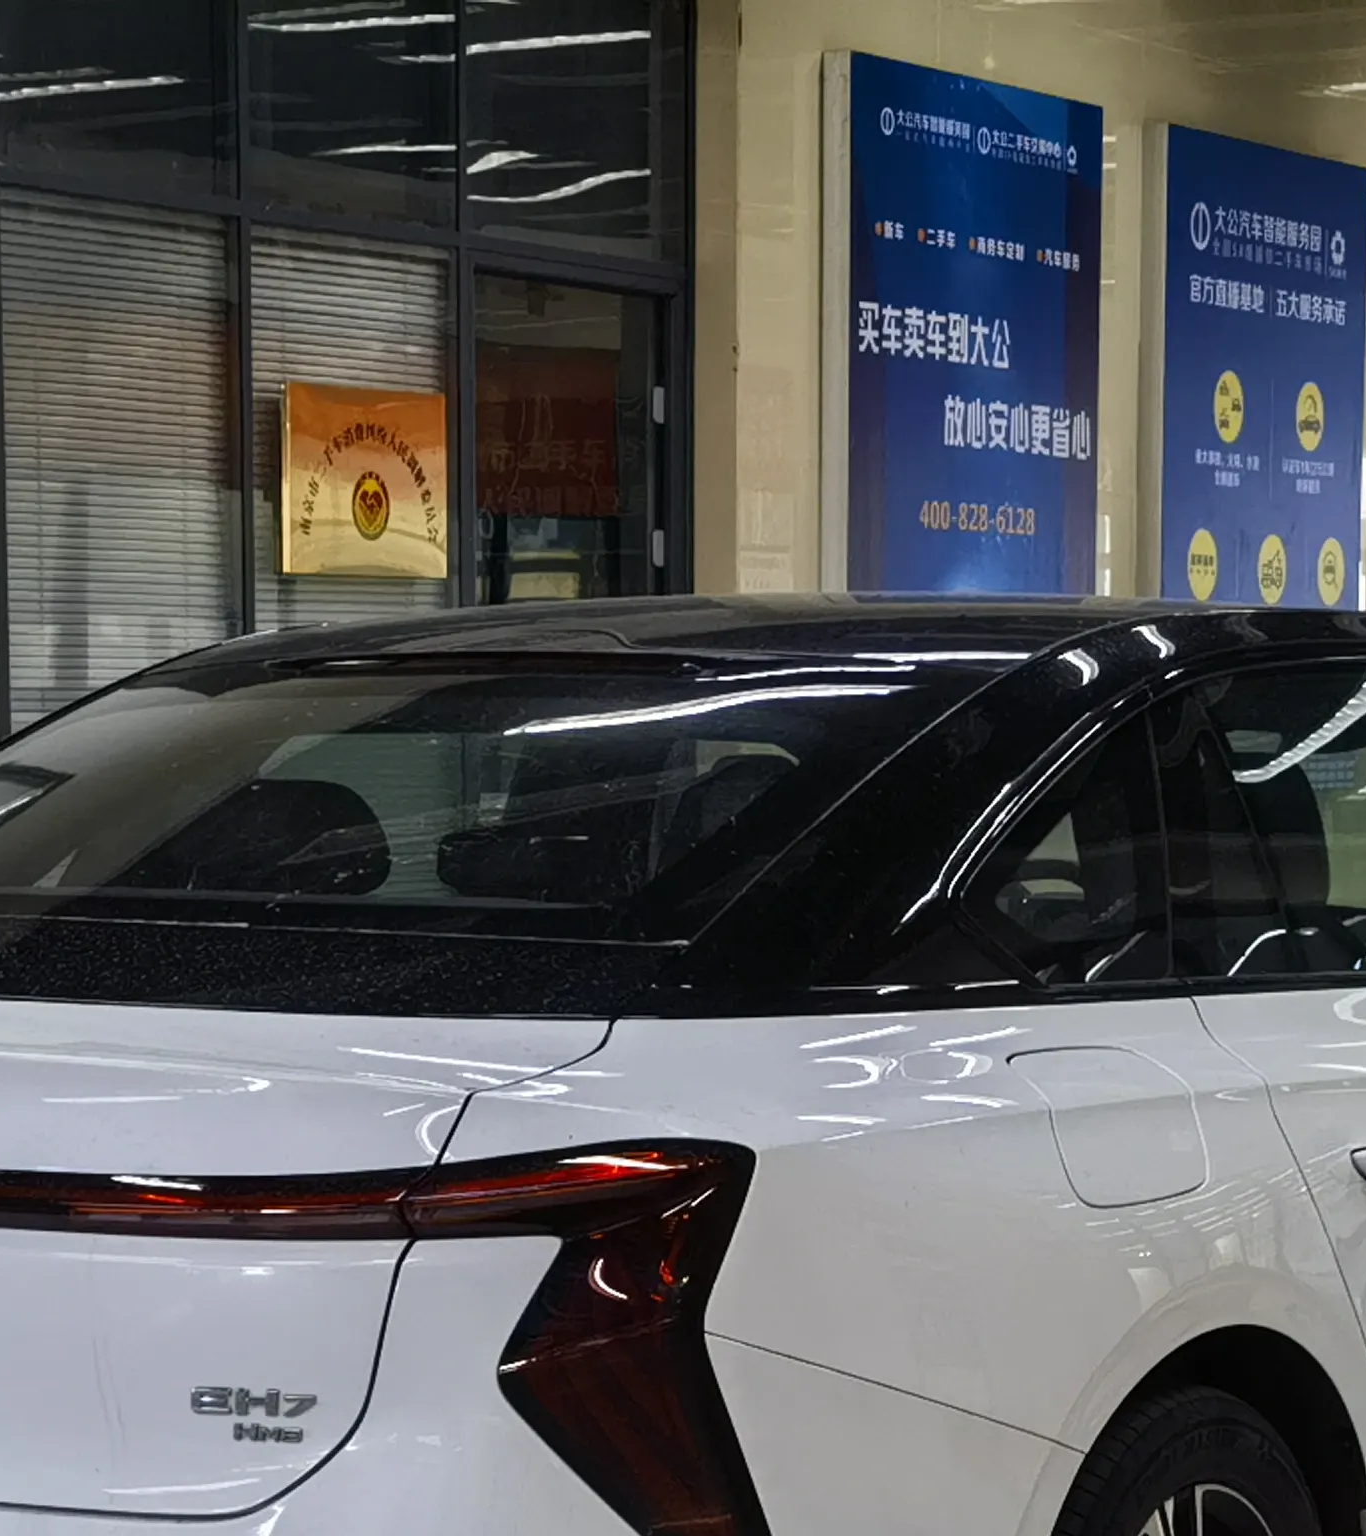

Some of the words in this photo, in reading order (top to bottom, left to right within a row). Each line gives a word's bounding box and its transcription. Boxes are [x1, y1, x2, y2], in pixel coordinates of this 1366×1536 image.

[884, 220, 904, 241] 新车
[926, 230, 956, 250] 二手车
[977, 237, 1025, 262] 商务车定制
[1044, 249, 1080, 272] 汽车服务
[1214, 206, 1322, 252] 大公汽车智能服务园
[1189, 274, 1265, 314] 官方直播基地
[1275, 289, 1347, 326] 五大服务承诺
[858, 300, 1011, 369] 买车卖车到大公
[944, 394, 1091, 461] 放心安心更省心
[919, 500, 1036, 535] 400-828-6128
[190, 1385, 318, 1419] EH7
